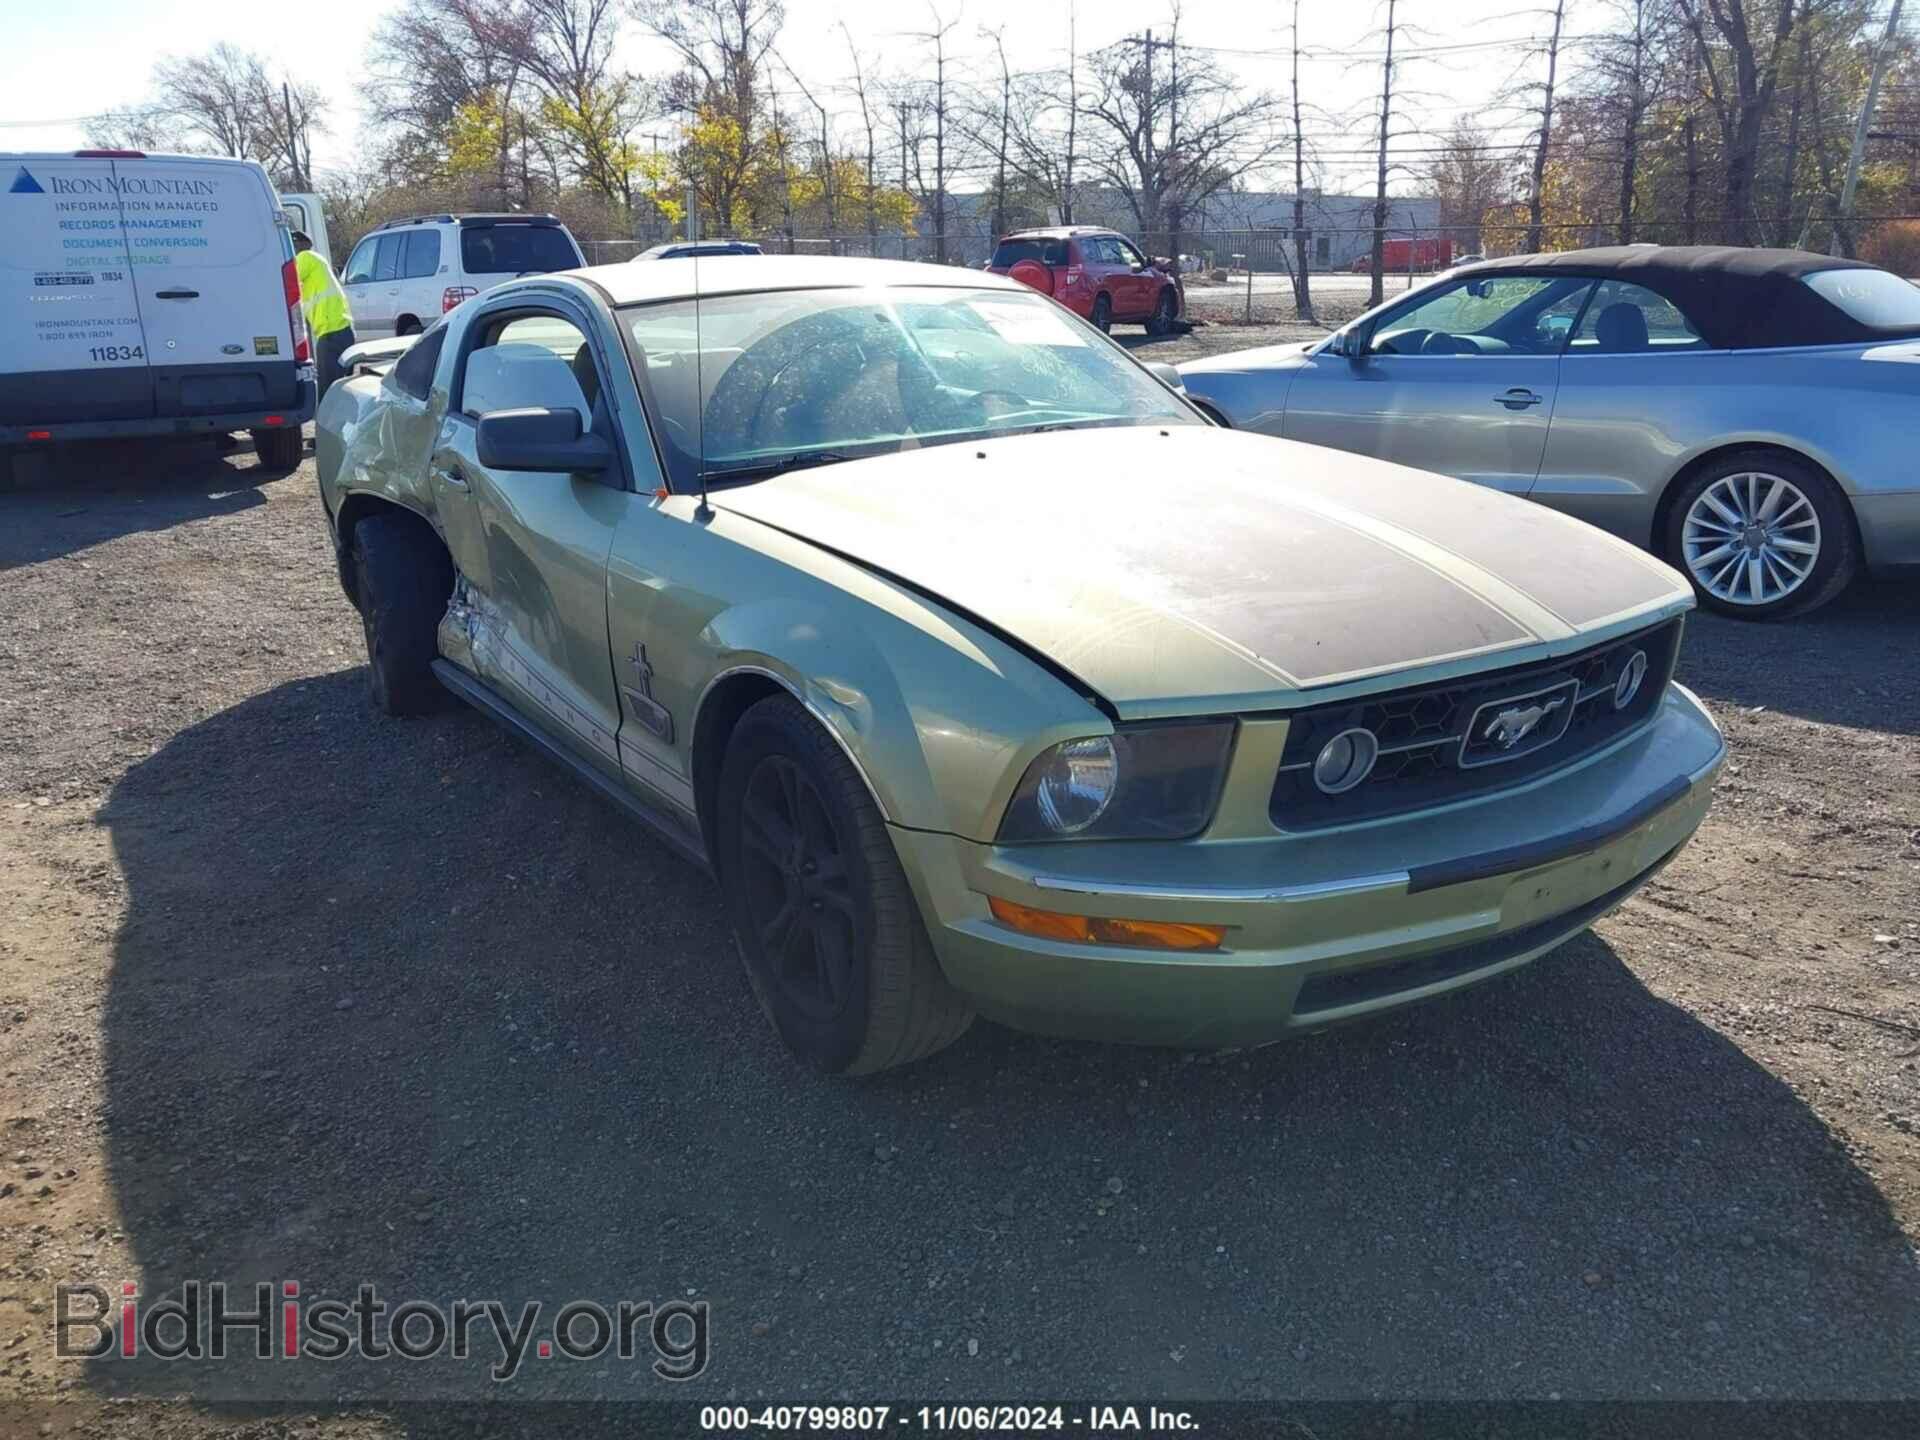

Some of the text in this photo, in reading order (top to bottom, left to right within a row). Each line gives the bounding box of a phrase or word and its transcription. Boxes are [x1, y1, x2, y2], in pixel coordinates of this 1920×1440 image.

[49, 176, 214, 195] IRON MOUNTAIN
[55, 201, 218, 212] INFORMATION MANAGED
[59, 219, 203, 230] RECORDS MANAGEMENT
[63, 238, 208, 249] DOCUMENT CONVERSION
[66, 256, 110, 267] DIGITAL
[88, 345, 144, 362] 11834
